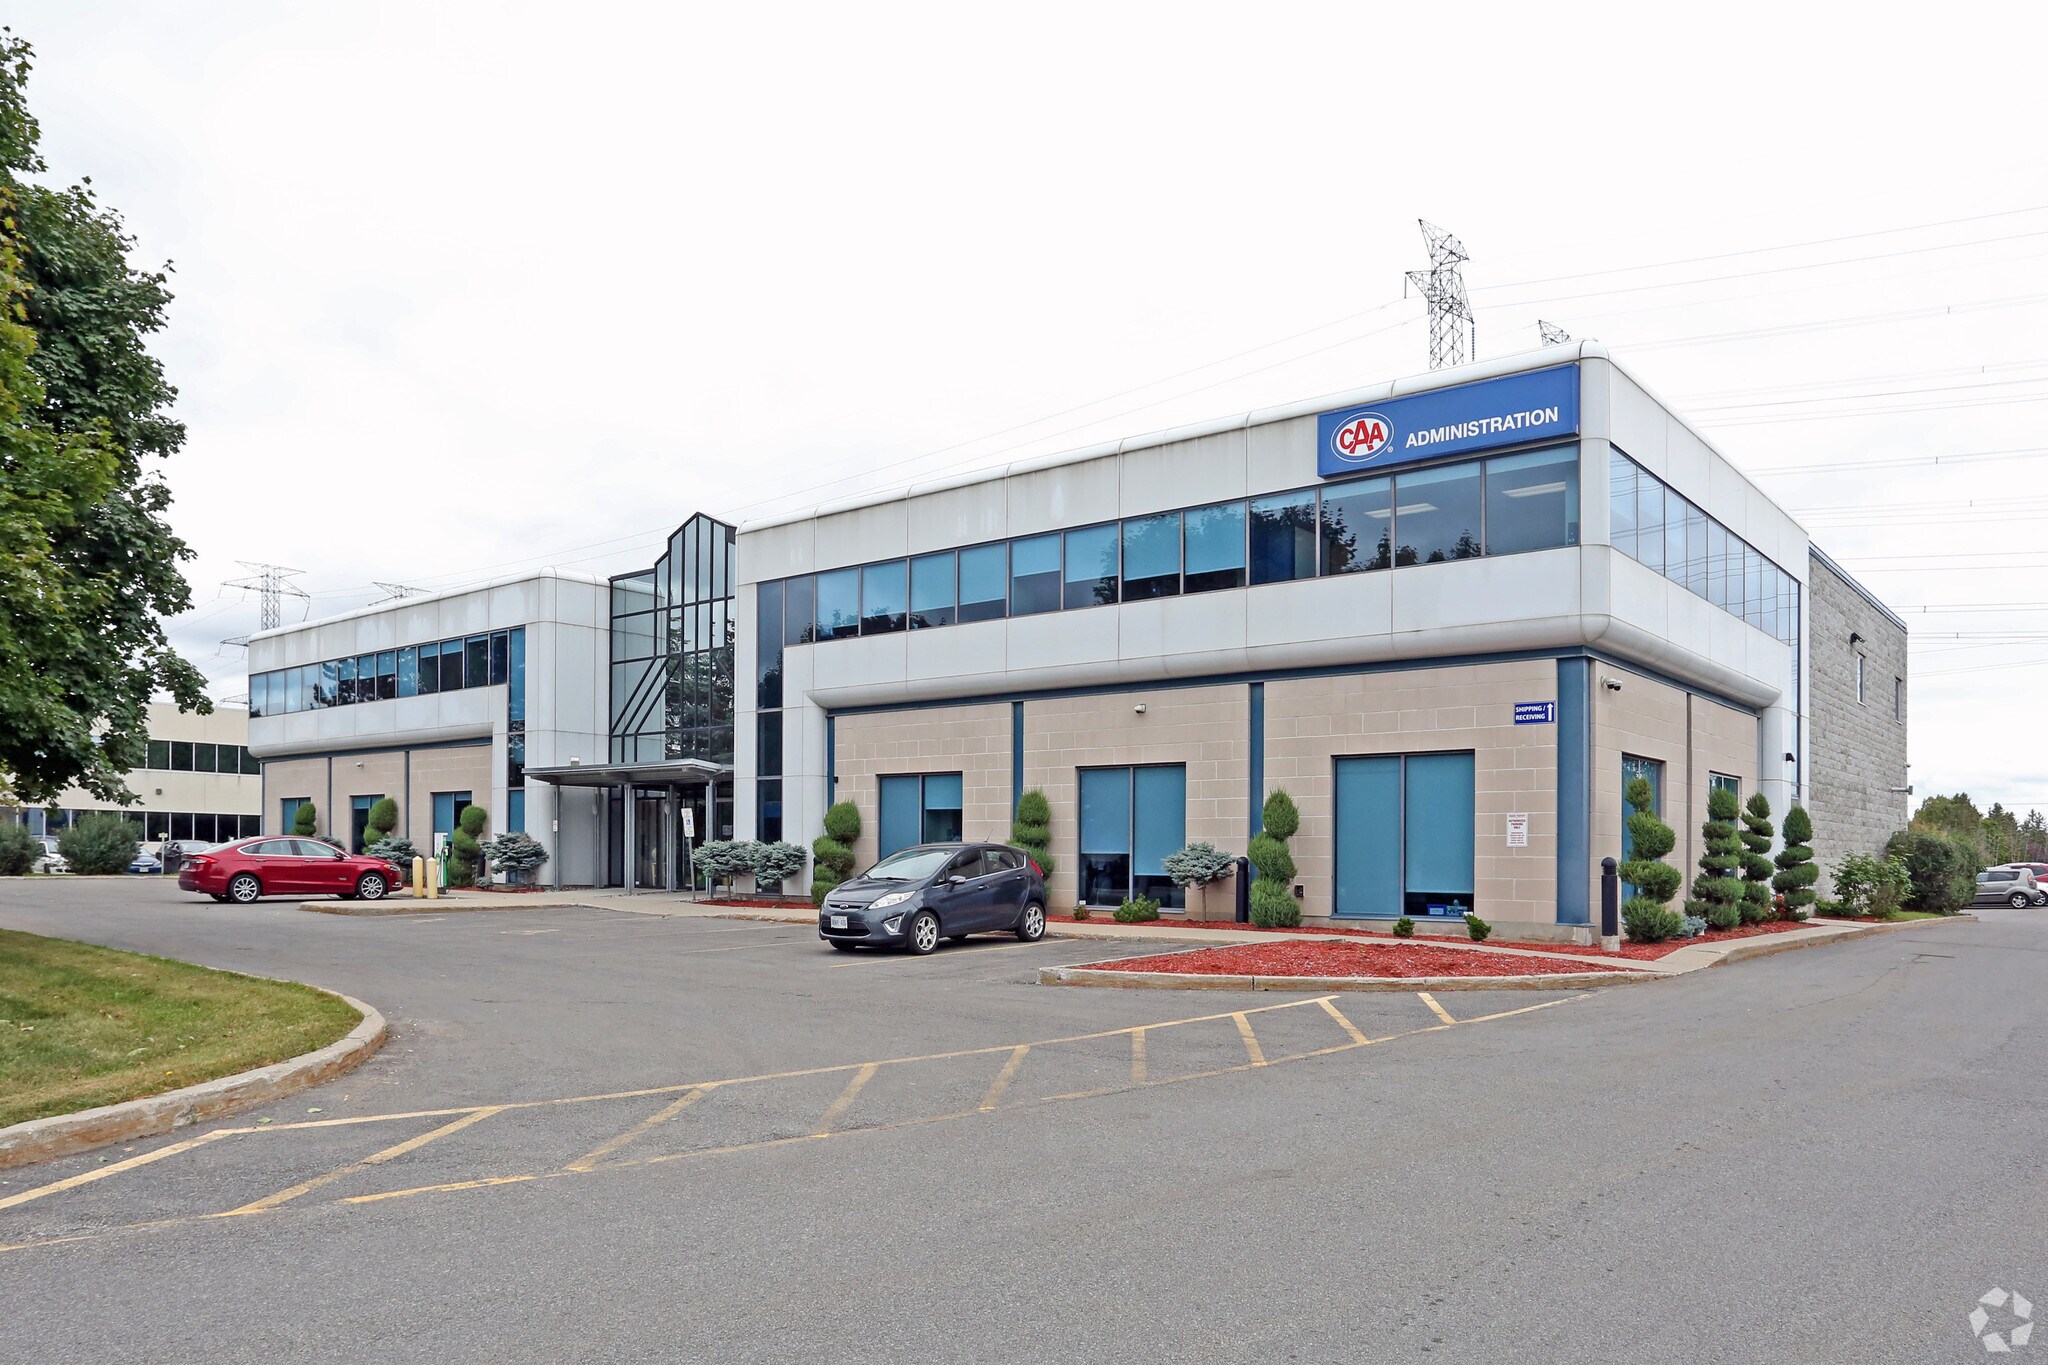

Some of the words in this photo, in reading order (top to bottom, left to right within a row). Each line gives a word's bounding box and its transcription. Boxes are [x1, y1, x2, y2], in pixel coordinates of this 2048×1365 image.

[1339, 419, 1385, 454] CAA
[1405, 406, 1559, 448] ADMINISTRATION
[1515, 705, 1542, 713] SHIPPING
[1515, 713, 1546, 721] RECEIVING
